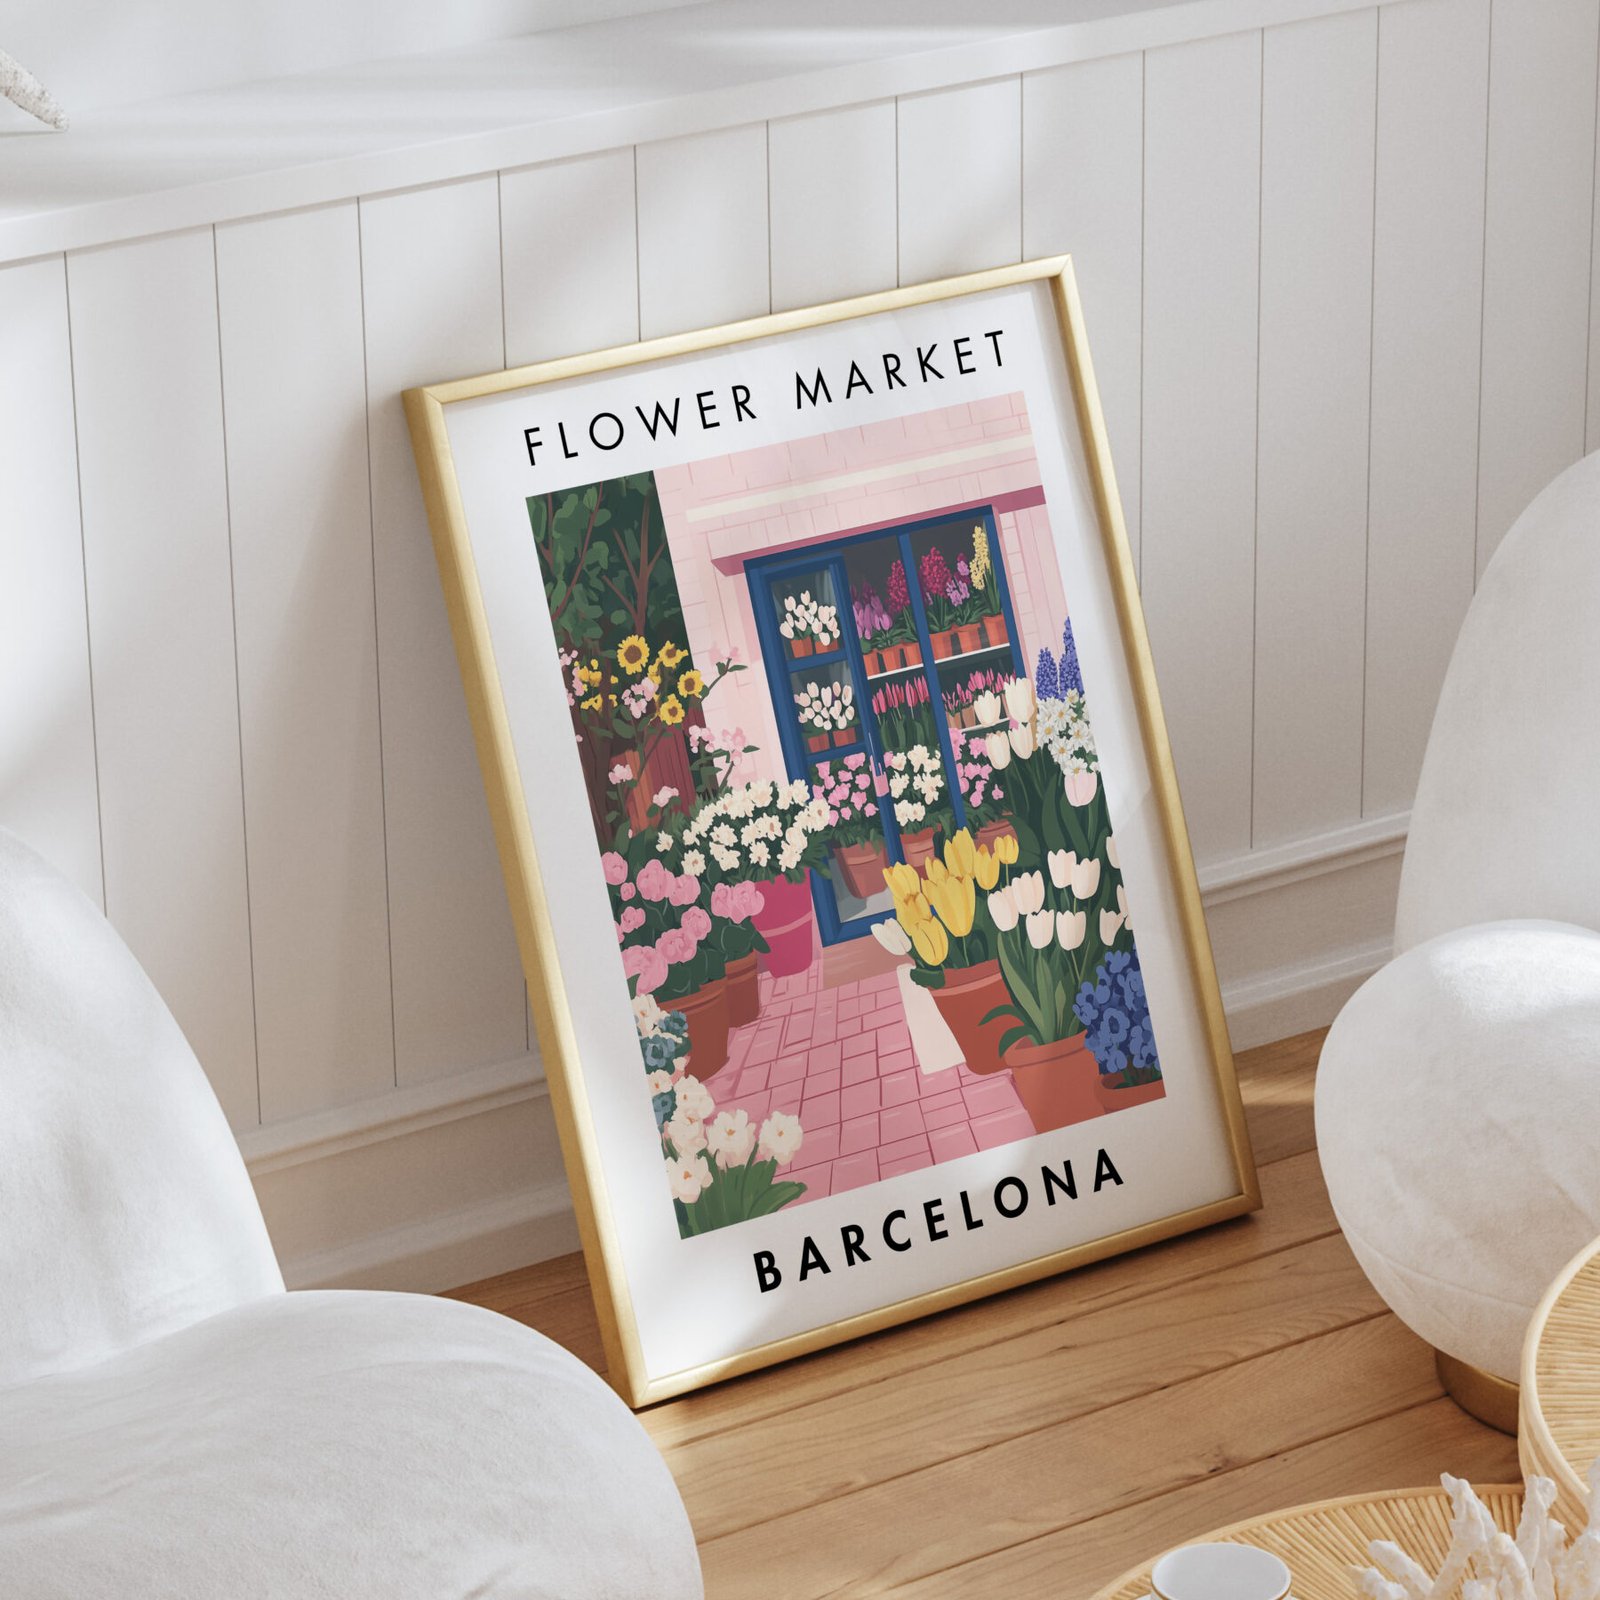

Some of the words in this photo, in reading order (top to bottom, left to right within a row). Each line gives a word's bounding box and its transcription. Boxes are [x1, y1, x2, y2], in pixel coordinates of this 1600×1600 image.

[524, 384, 757, 467] FLOWER
[795, 330, 1007, 410] MARKET
[753, 1148, 1124, 1294] BARCELONA
